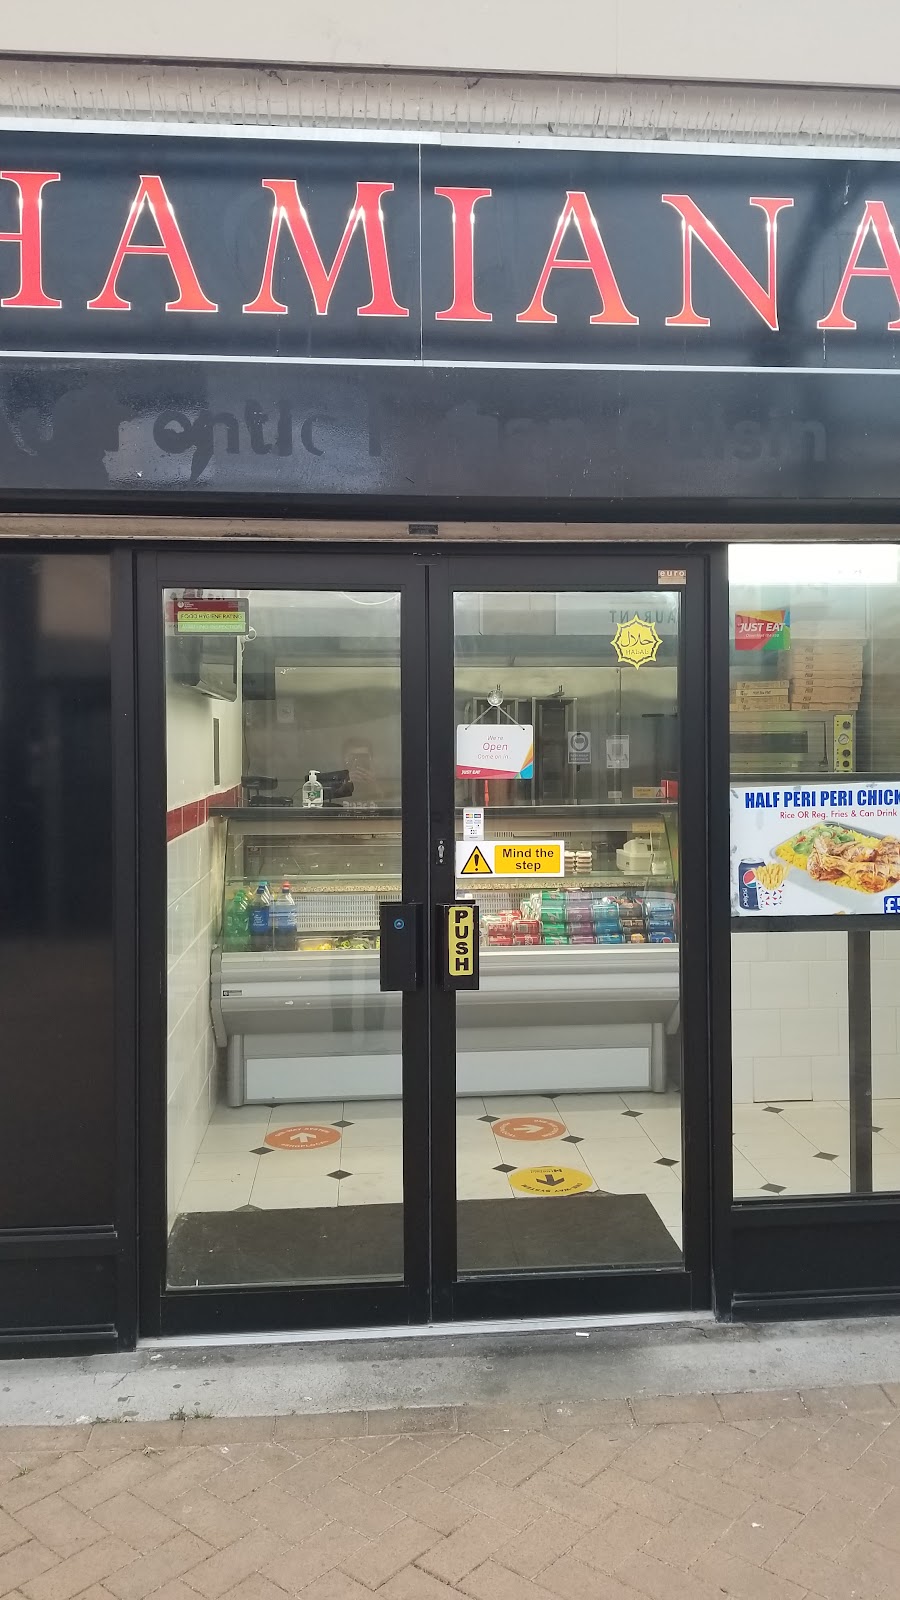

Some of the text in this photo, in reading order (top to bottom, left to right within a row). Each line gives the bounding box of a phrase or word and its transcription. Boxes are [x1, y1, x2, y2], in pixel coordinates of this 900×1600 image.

[659, 569, 685, 577] euro
[738, 622, 786, 633] JUST EAT
[620, 630, 653, 647] حلال
[482, 742, 508, 752] Open
[745, 792, 780, 808] HALF
[783, 791, 816, 808] PERI
[820, 790, 853, 807] PERI
[811, 811, 828, 820] Reg.
[831, 810, 848, 818] Fries
[877, 809, 898, 817] Drink
[502, 848, 554, 858] Mind the
[515, 860, 541, 872] step
[455, 910, 470, 971] PUSH
